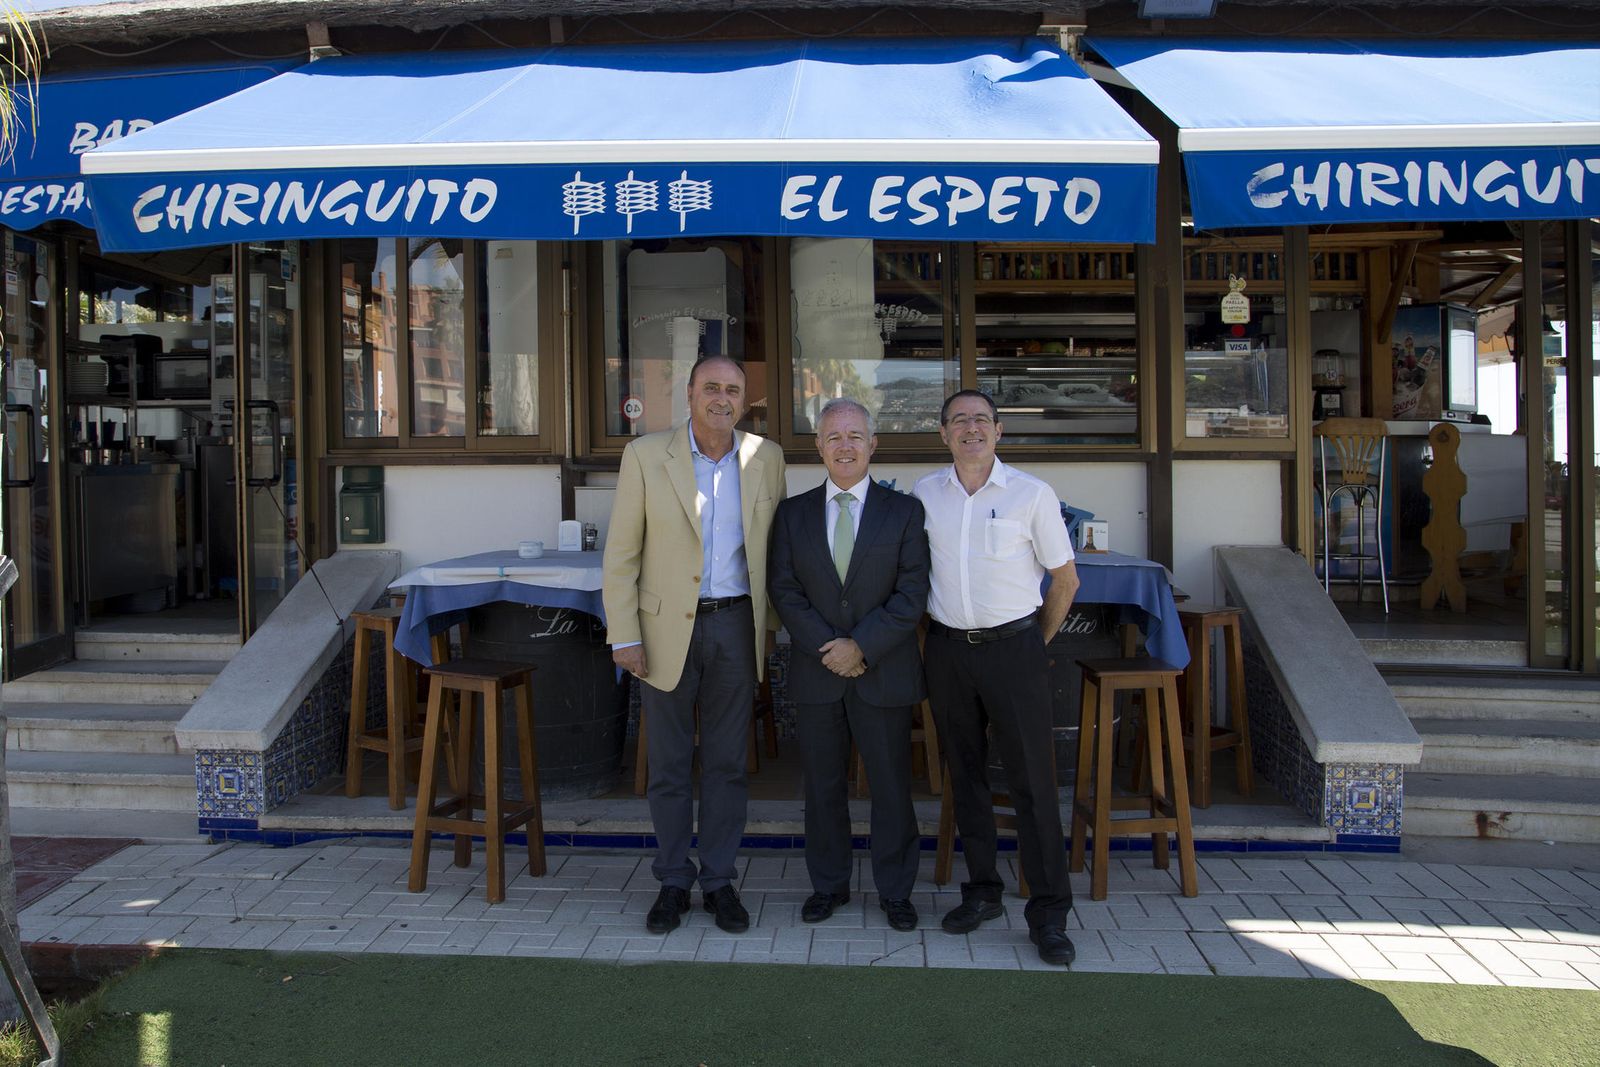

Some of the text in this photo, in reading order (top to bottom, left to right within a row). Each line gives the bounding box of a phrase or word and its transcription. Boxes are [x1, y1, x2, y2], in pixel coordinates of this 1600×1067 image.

[0, 181, 93, 215] ESTA
[132, 177, 498, 234] CHIRINGUITO
[780, 175, 1101, 227] EL ESPETO
[1230, 343, 1248, 351] VISA
[1059, 612, 1098, 634] ita
